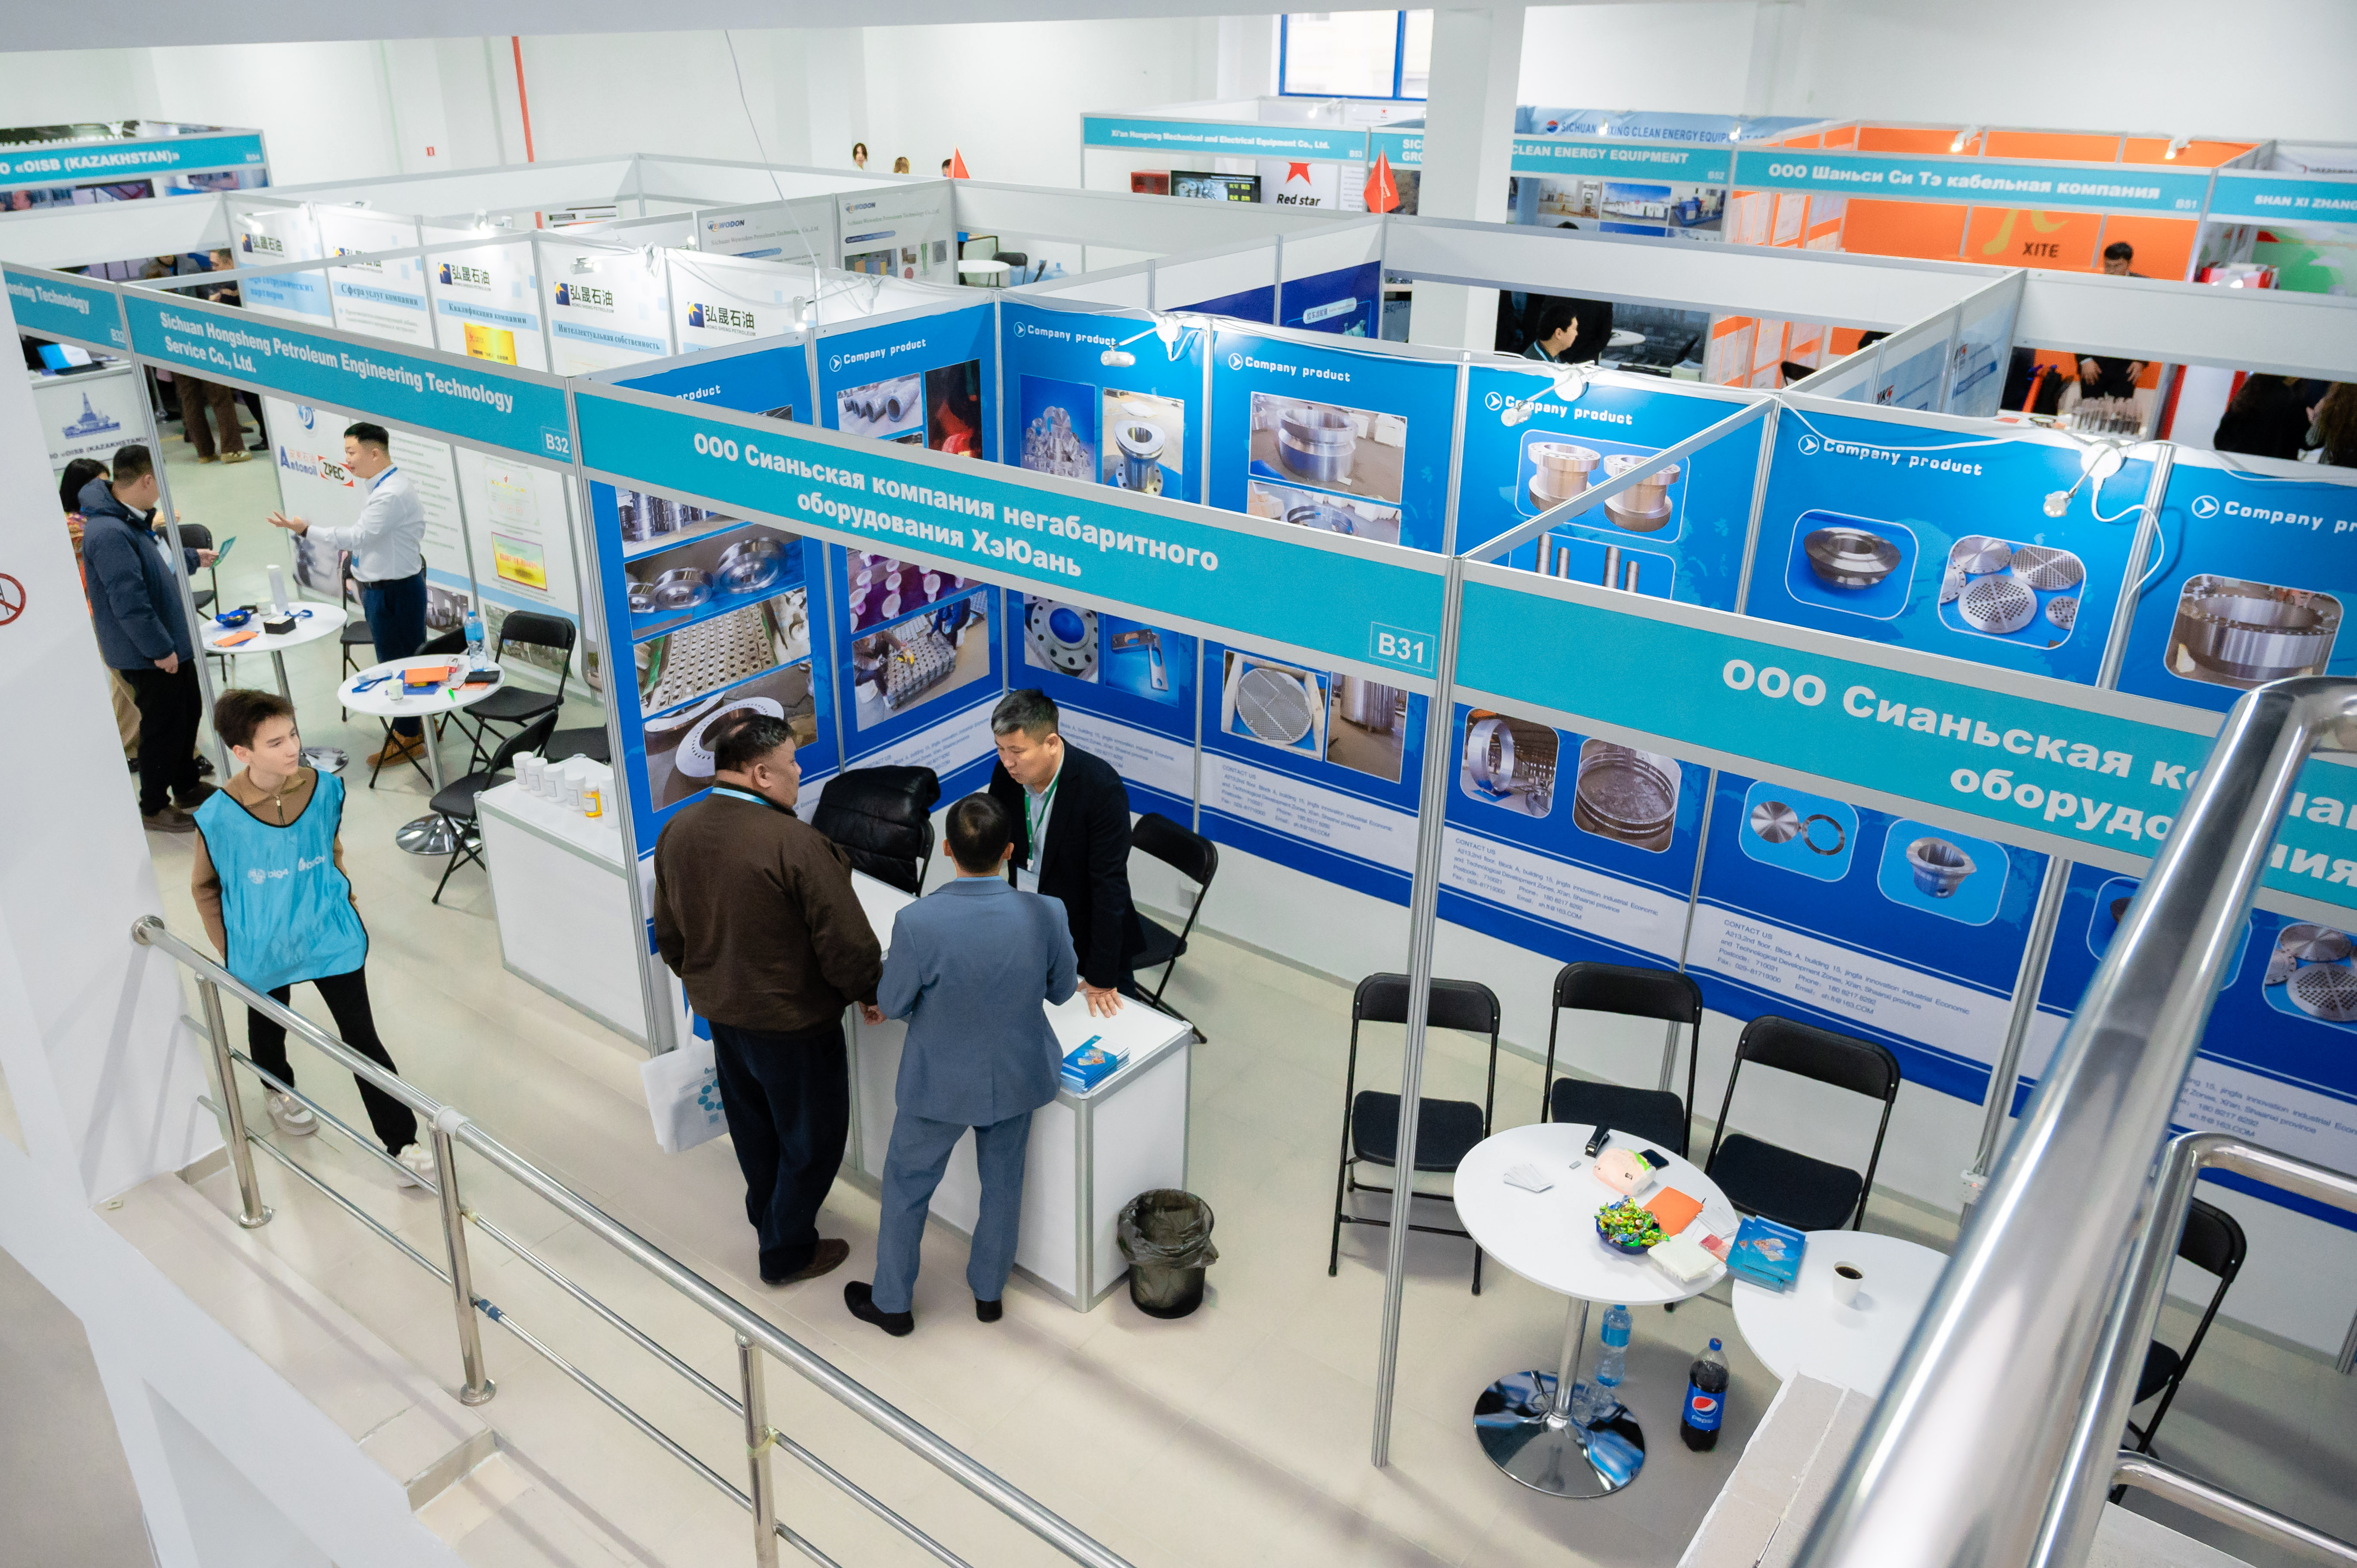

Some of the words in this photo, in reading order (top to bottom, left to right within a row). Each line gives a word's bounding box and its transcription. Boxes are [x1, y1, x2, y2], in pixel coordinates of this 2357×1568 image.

[1163, 132, 1203, 142] Mechanical
[1204, 135, 1219, 143] and
[1219, 135, 1254, 145] Electrical
[1256, 137, 1296, 148] Equipment
[1403, 138, 1423, 150] SIC
[1561, 122, 1596, 134] SICHUAN
[1632, 127, 1661, 138] CLEAN
[1662, 129, 1698, 141] ENERGY
[1699, 131, 1746, 143] EQUIP
[1512, 145, 1551, 156] CLEAN
[1555, 147, 1607, 160] ENERGY
[1610, 149, 1689, 164] EQUIPMENT
[1769, 163, 1808, 178] ООО
[1812, 166, 1884, 183] Шаньси
[1888, 169, 1913, 185] Си
[1918, 172, 1942, 187] Тэ
[1946, 174, 2051, 193] кабельная
[2056, 182, 2160, 199] компания
[1277, 194, 1297, 205] Red
[1299, 194, 1321, 207] star
[2254, 194, 2292, 207] SHAN
[2294, 197, 2310, 208] XI
[708, 219, 745, 232] WEWODON
[2022, 241, 2060, 258] XITE
[451, 265, 490, 285] 弘晟石油
[36, 285, 89, 315] Technology
[342, 284, 365, 296] Сфера
[365, 289, 383, 300] услуг
[385, 291, 418, 306] компании
[569, 285, 613, 307] 弘晟石油
[448, 303, 492, 319] Квалификация
[494, 313, 527, 324] компании
[705, 305, 754, 329] 弘晟石油
[558, 324, 613, 342] Интеллектуальная
[614, 336, 659, 350] собственность
[732, 329, 755, 337] PETROLEUM
[1028, 324, 1071, 342] Company
[160, 312, 204, 337] Sichuan
[206, 322, 271, 356] Hongsheng
[273, 338, 339, 368] Petroleum
[341, 353, 423, 392] Engineering
[425, 372, 513, 413] Technology
[165, 336, 207, 360] Service
[208, 347, 232, 370] Co.,
[233, 353, 257, 373] Ltd.
[843, 350, 886, 366] Company
[890, 338, 926, 355] product
[1245, 357, 1297, 376] Company
[1302, 366, 1351, 382] product
[1574, 409, 1633, 426] product
[545, 433, 570, 454] B32
[1824, 439, 1901, 465] Company
[1909, 455, 1983, 476] product
[323, 462, 345, 481] ZPEC
[694, 433, 739, 461] ООО
[746, 445, 865, 490] Сианьская
[873, 478, 994, 520] компания
[1004, 507, 1218, 572] негабаритного
[2224, 501, 2323, 531] Company
[797, 491, 964, 549] оборудования
[971, 529, 1082, 576] ХэЮань
[1378, 634, 1426, 664] B31
[1723, 659, 1826, 707] ООО
[1843, 685, 2133, 778] Сианьская
[1951, 767, 2357, 888] оборудоия
[1455, 837, 1485, 851] CONTACT
[1466, 859, 1501, 875] Technological
[1501, 870, 1536, 886] Development
[1595, 901, 1620, 914] province
[1523, 869, 1543, 880] building
[1572, 884, 1601, 897] innovation
[1602, 893, 1628, 906] industrial
[1630, 901, 1658, 916] Economic
[1724, 919, 1760, 936] CONTACT
[1762, 931, 1772, 940] US
[1721, 938, 1732, 947] and
[1735, 943, 1777, 962] Technological
[1778, 957, 1820, 976] Development
[1892, 995, 1921, 1010] province
[1774, 945, 1792, 957] Block
[1804, 956, 1829, 970] building
[1865, 976, 1899, 992] innovation
[1902, 987, 1933, 1003] industrial
[1935, 998, 1970, 1015] Economic
